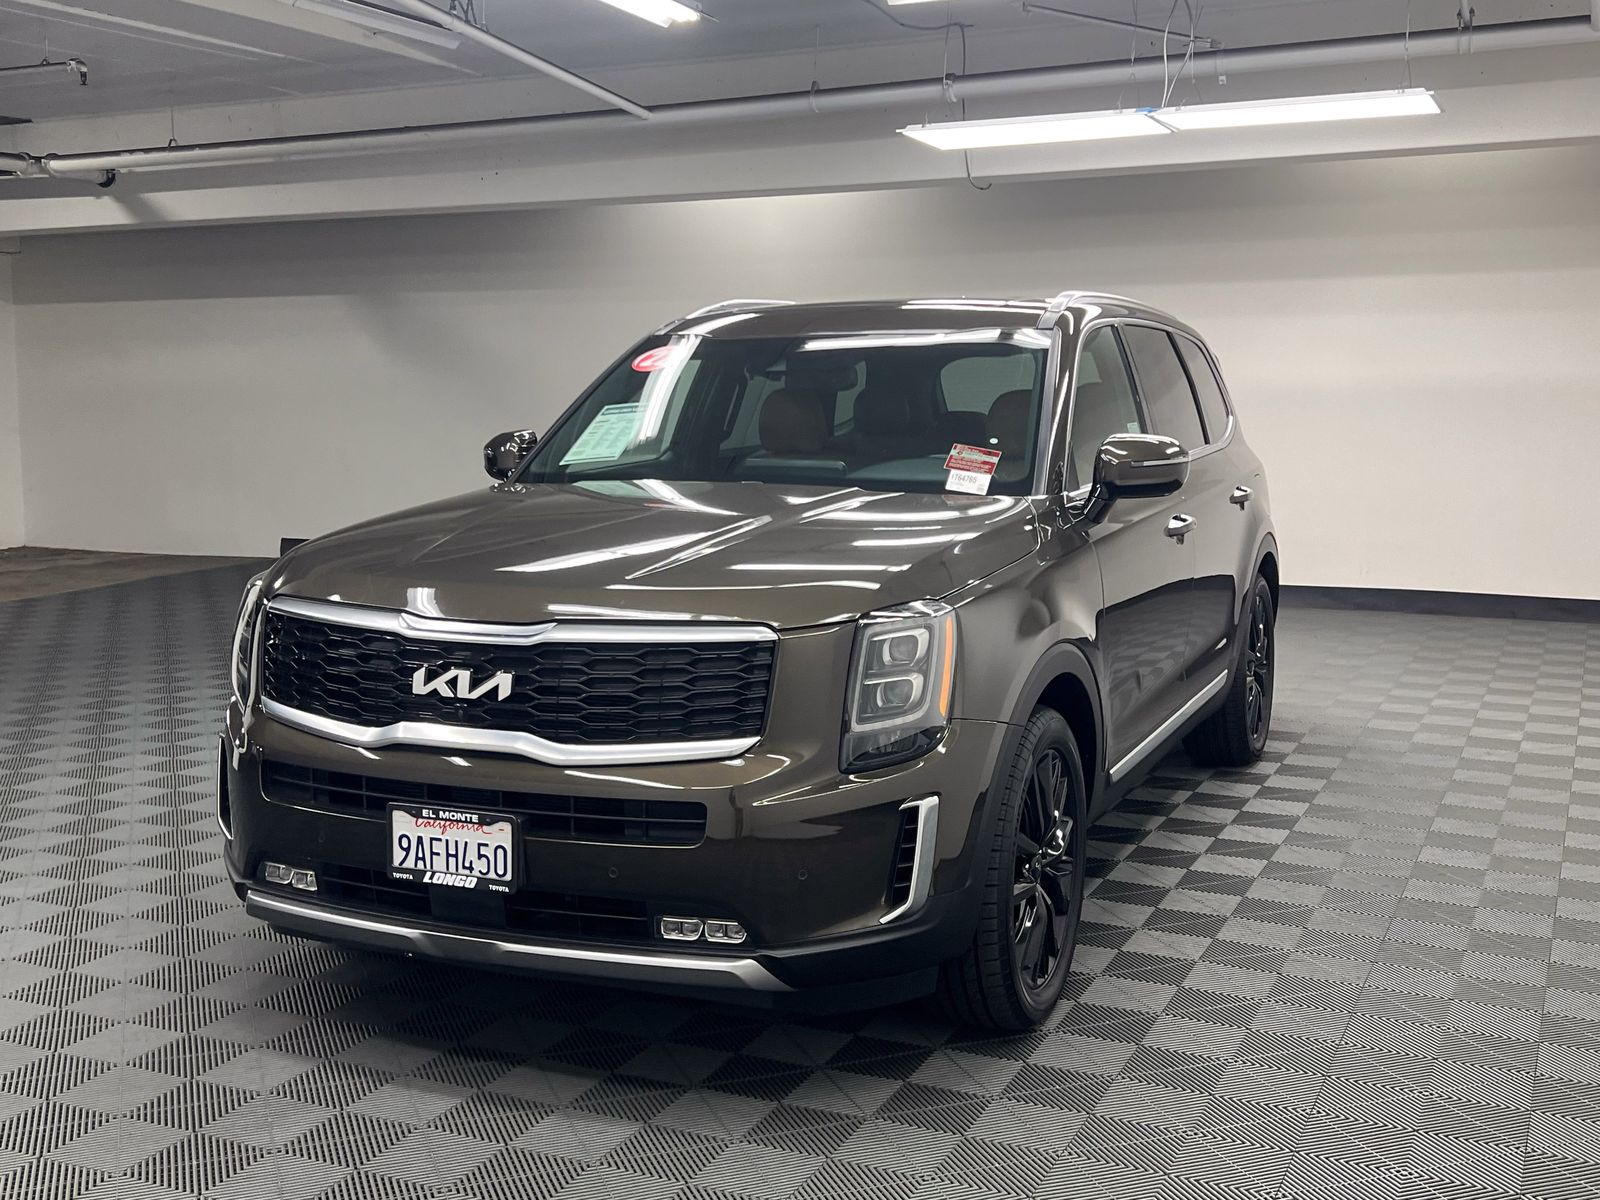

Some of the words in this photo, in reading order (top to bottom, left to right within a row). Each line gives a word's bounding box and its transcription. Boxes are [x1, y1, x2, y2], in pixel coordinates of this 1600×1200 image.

[412, 666, 512, 701] KIA
[422, 809, 436, 818] EL
[439, 811, 479, 823] MONTE
[398, 834, 508, 877] 9AFH450
[392, 872, 413, 880] TOYOTA
[423, 871, 478, 888] LONGO
[488, 884, 509, 892] TOYOTA
